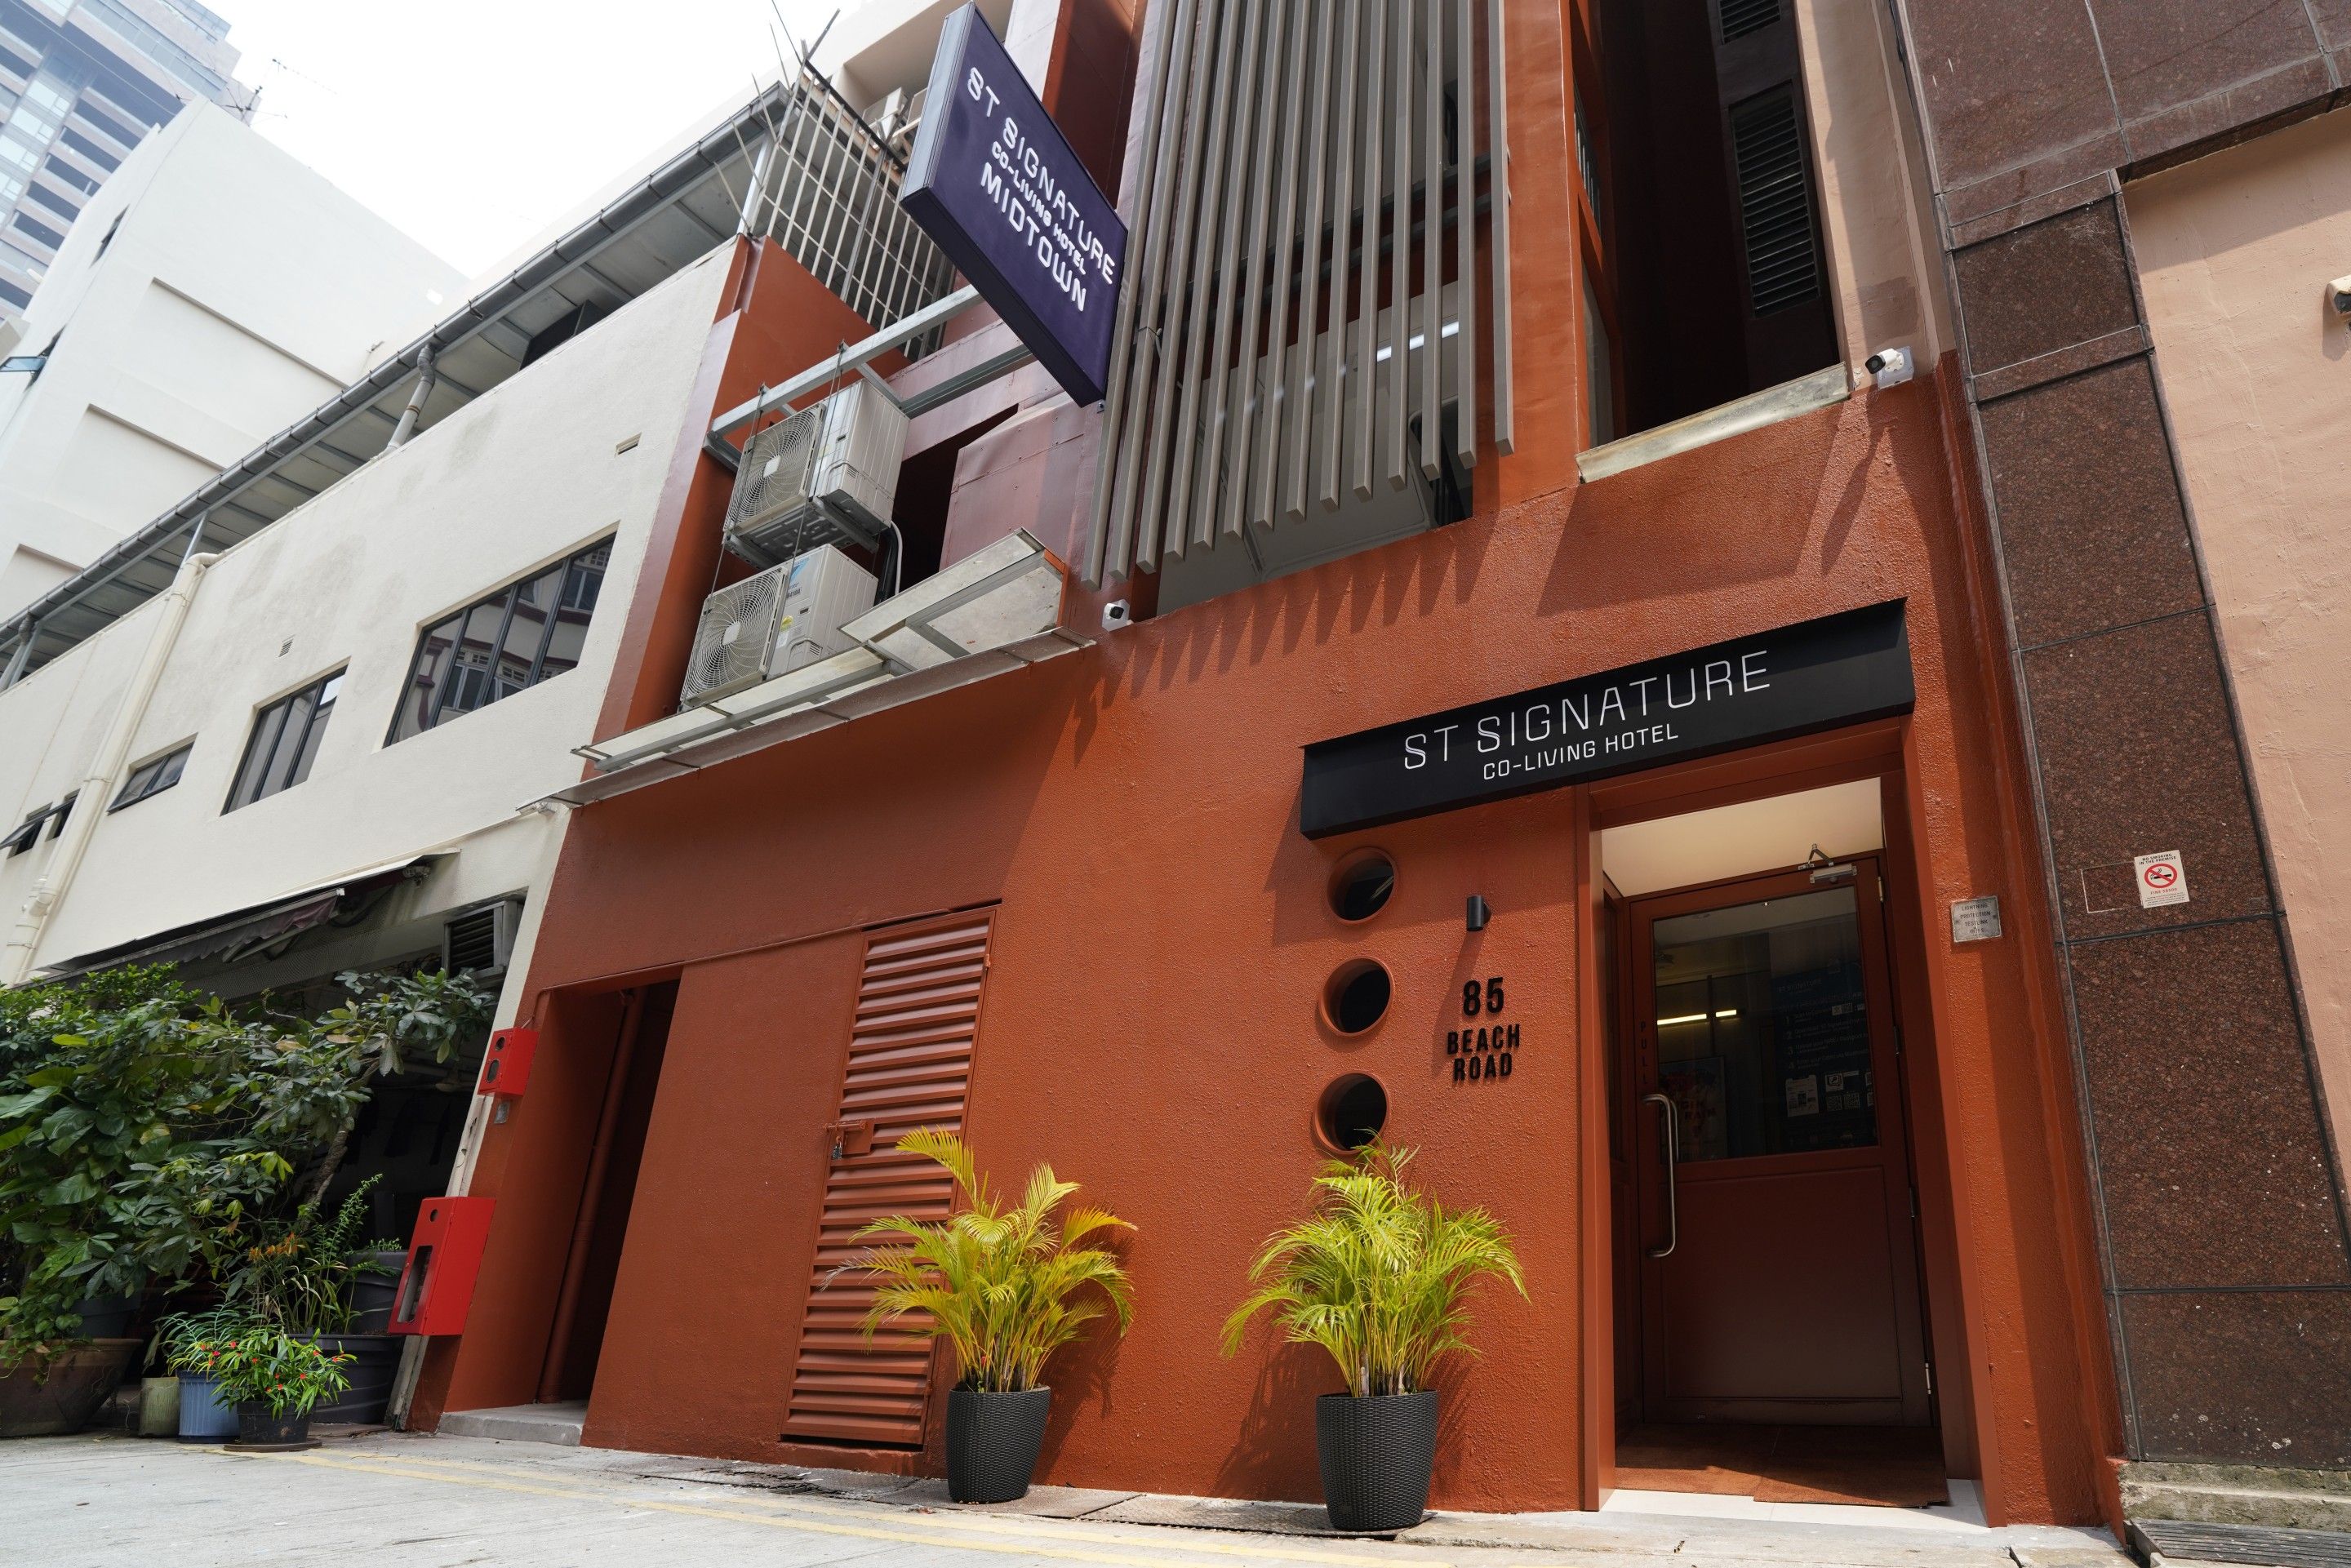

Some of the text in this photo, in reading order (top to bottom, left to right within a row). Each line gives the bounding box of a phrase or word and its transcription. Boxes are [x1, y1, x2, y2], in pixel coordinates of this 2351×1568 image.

[967, 67, 1115, 284] ST SIGNATURE
[992, 141, 1086, 275] CO-LIVING HOTEL
[980, 162, 1086, 312] MIDTOWN
[1404, 650, 1771, 770] ST SIGNATURE
[1483, 723, 1679, 780] CO-LIVING HOTEL
[1960, 911, 1991, 919] PROTECTION
[1962, 903, 1988, 911] LIGHTNING
[1463, 976, 1504, 1017] 85
[1447, 1024, 1520, 1055] BEACH
[1453, 1052, 1513, 1082] ROAD
